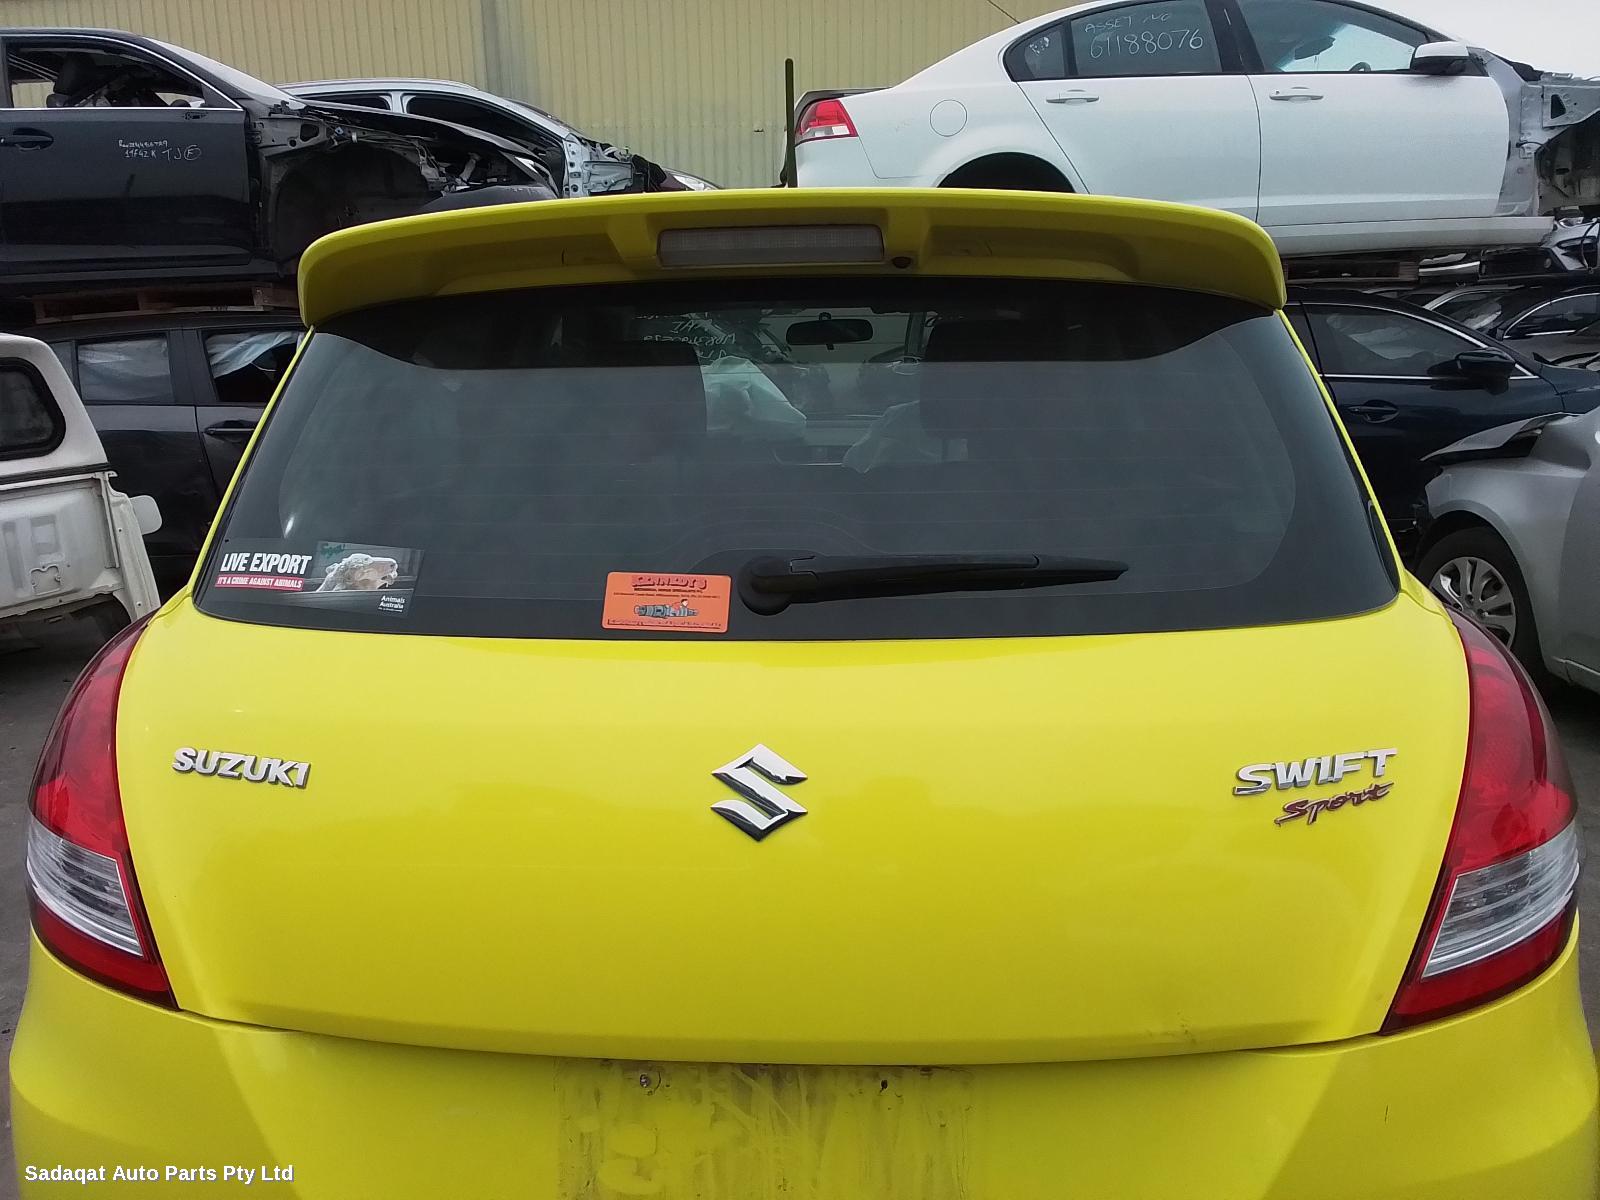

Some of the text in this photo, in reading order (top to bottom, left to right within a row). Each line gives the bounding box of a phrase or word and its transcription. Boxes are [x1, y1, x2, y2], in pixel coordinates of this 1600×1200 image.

[1085, 16, 1132, 33] ASSET
[1090, 28, 1204, 58] 61188076
[220, 552, 313, 575] LIVE EXPORT
[231, 577, 249, 585] CRIME
[248, 577, 275, 587] AGAINST
[274, 578, 303, 589] ANIMALS
[379, 601, 404, 609] Australia
[381, 595, 406, 604] Animals
[172, 746, 311, 789] SUZUKI
[1232, 748, 1398, 796] SWIFT
[1274, 781, 1394, 827] Sport
